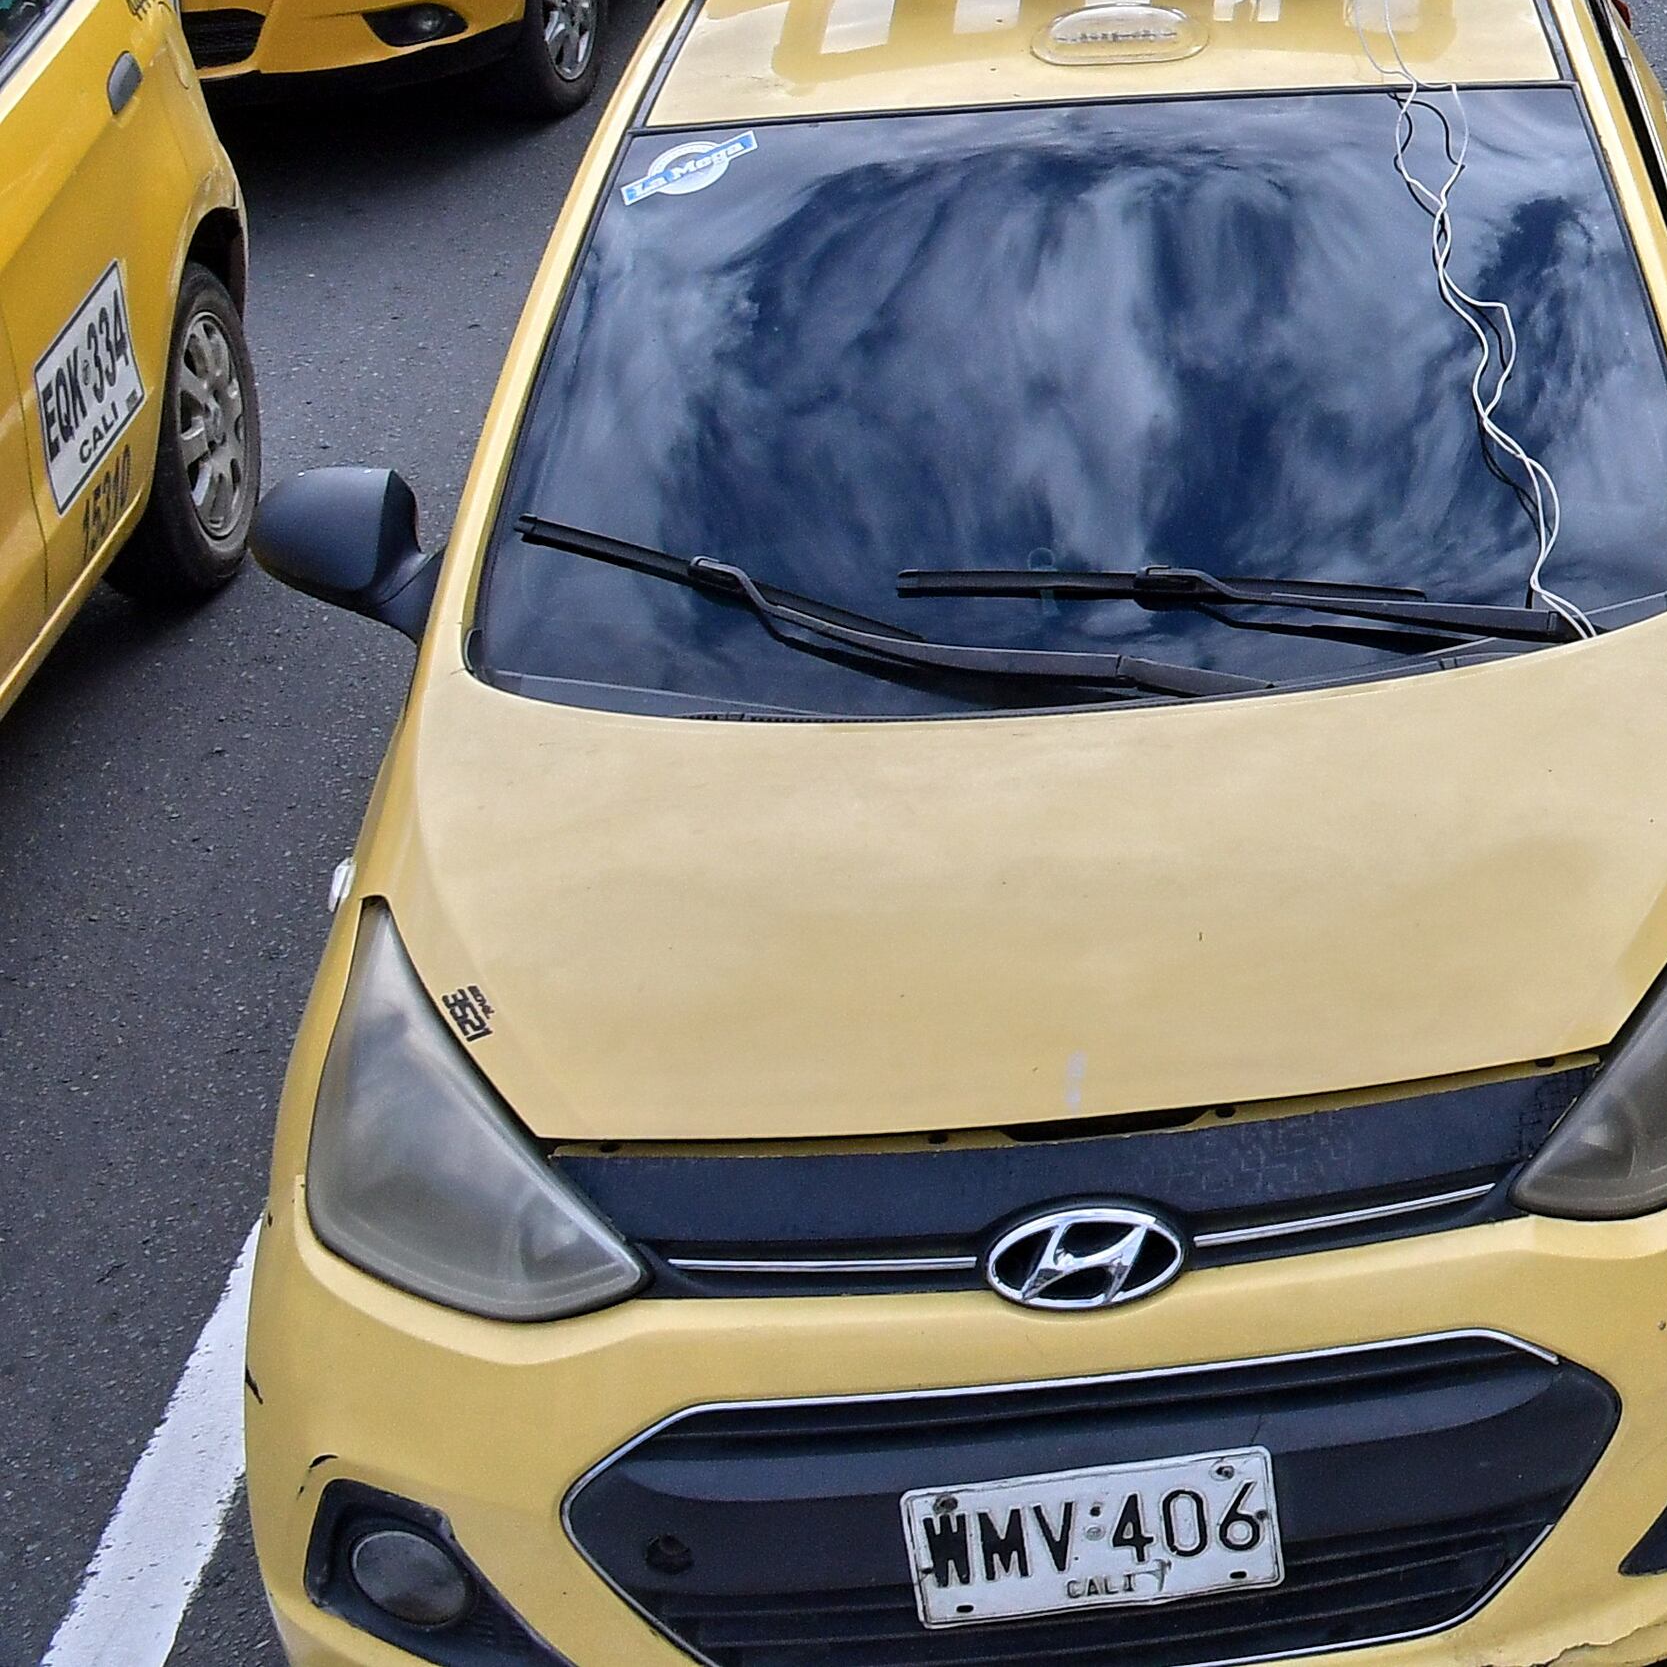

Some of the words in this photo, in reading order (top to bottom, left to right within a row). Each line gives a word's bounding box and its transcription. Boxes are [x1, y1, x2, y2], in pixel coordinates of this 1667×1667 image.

[79, 401, 119, 464] CALI
[442, 988, 493, 1042] 3521
[1066, 1574, 1135, 1599] CALI
